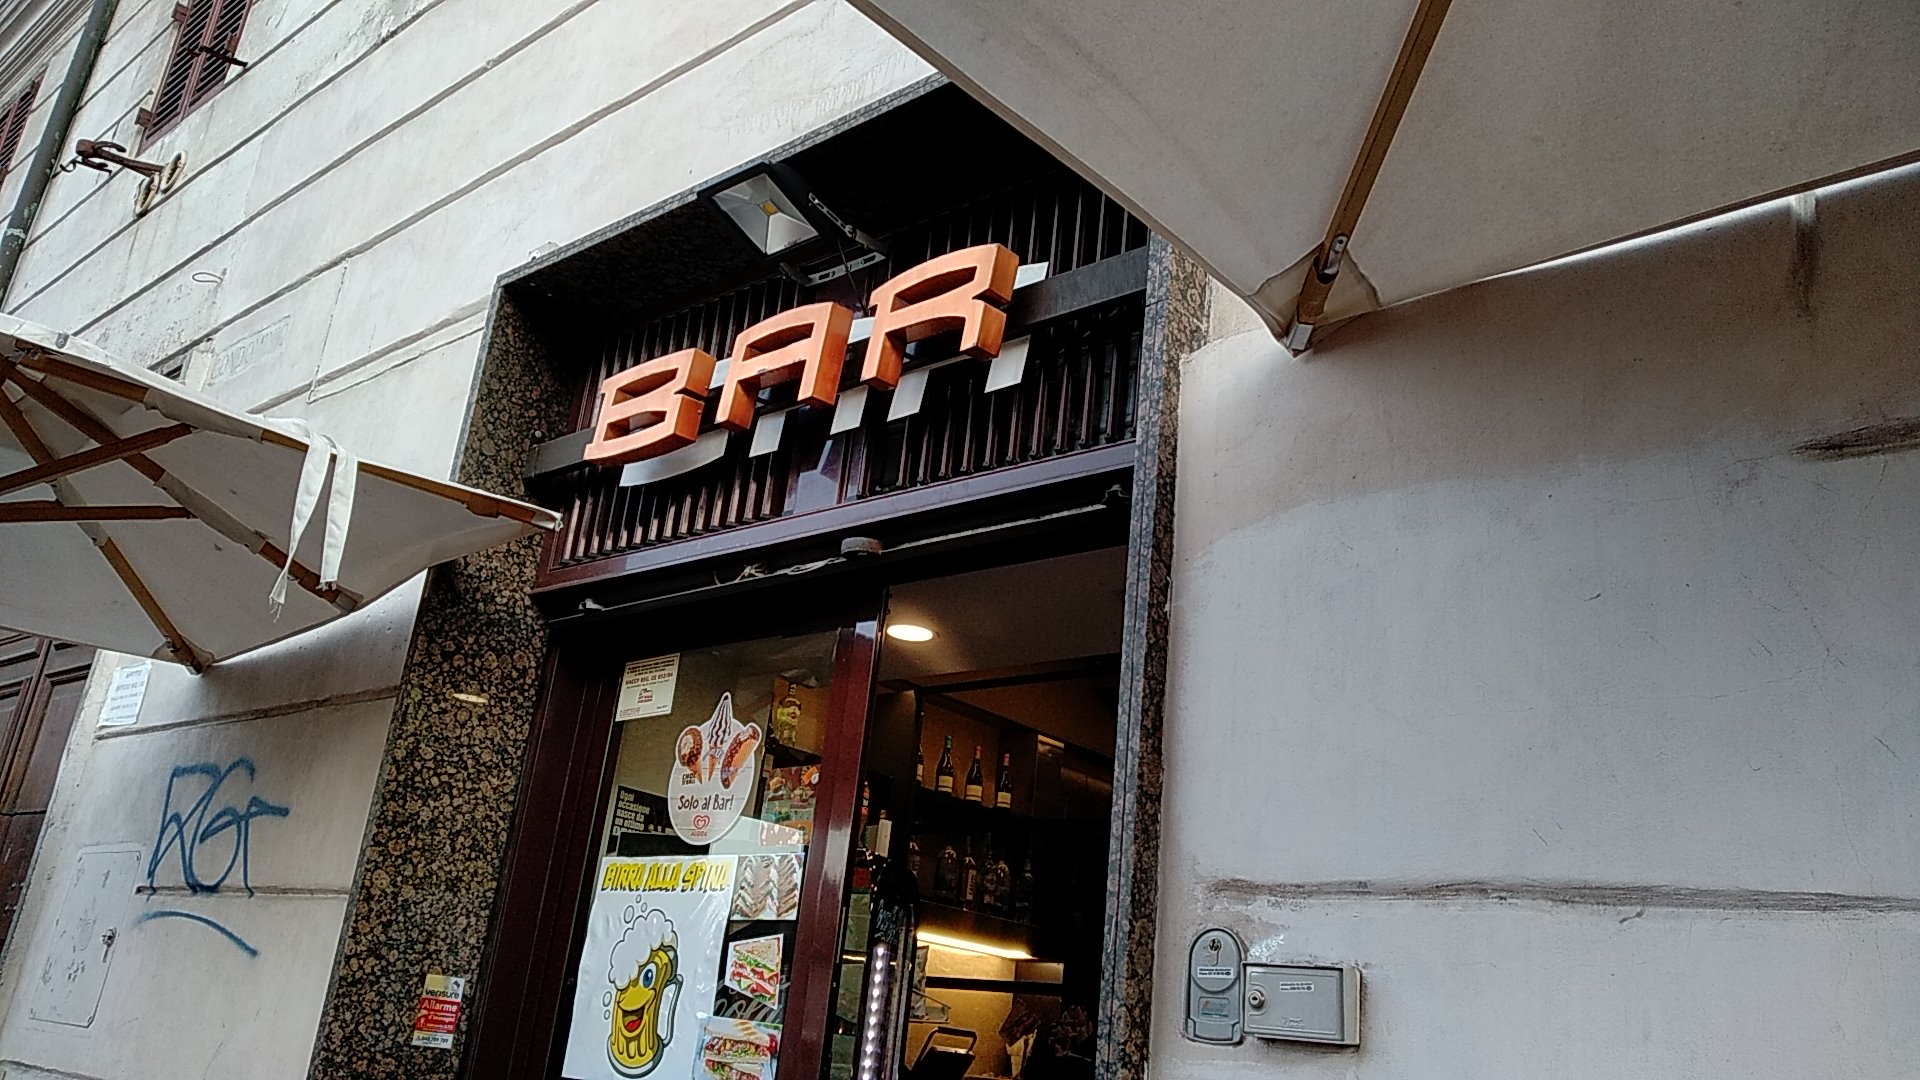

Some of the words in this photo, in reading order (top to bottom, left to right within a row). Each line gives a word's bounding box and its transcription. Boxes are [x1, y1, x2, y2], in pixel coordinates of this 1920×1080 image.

[584, 243, 1019, 464] BAR
[618, 800, 651, 815] occasione
[677, 794, 699, 811] Solo
[701, 795, 711, 811] al
[712, 793, 735, 811] Bar!
[616, 808, 636, 820] nasce
[635, 813, 645, 822] da
[601, 862, 646, 892] BIRRA
[642, 862, 683, 892] ALLA
[681, 859, 730, 893] SPINA
[425, 988, 460, 999] verisure
[421, 999, 458, 1013] Allarme
